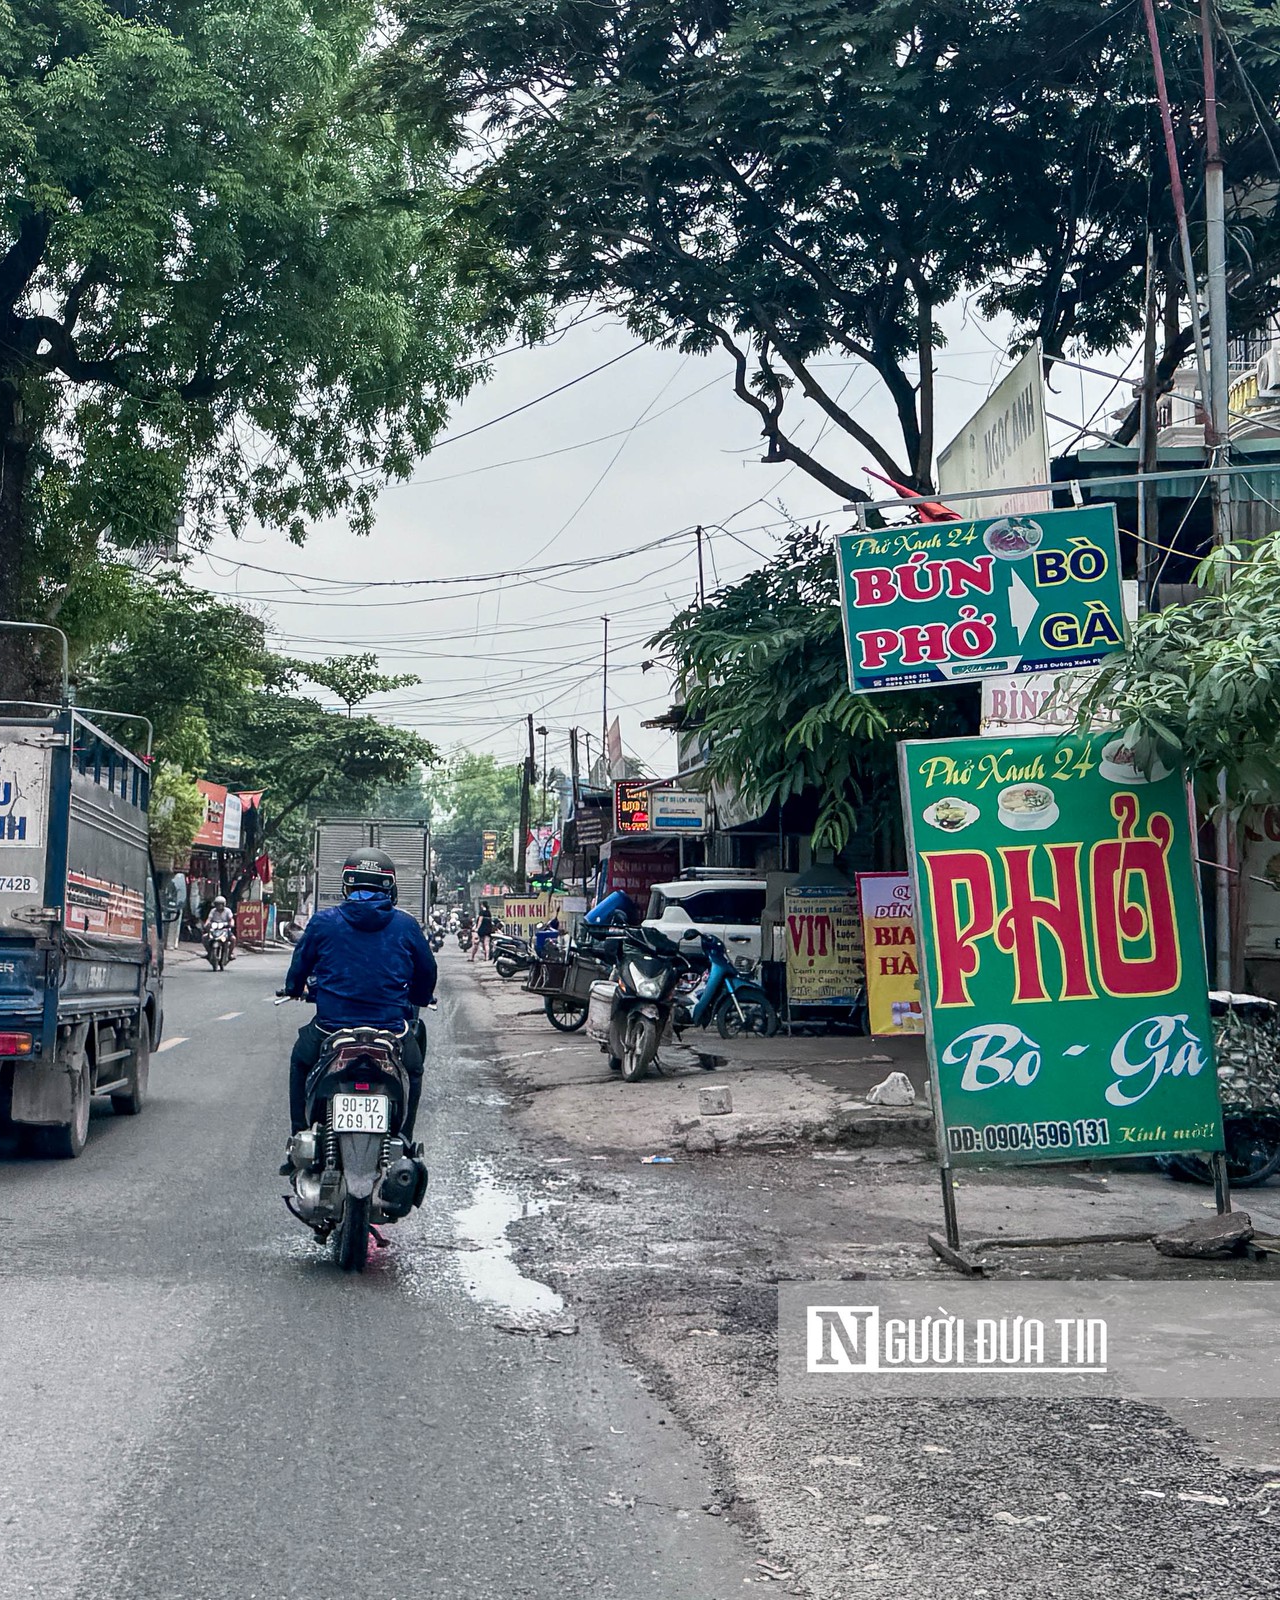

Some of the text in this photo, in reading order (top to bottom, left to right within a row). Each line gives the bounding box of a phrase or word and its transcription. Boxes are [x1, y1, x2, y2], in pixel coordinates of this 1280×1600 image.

[984, 409, 1012, 479] NGỌC
[1012, 381, 1036, 453] ANH
[946, 523, 979, 548] 24
[850, 552, 997, 608] BÚN
[1034, 536, 1108, 588] BÒ
[858, 605, 996, 670] PHỞ
[1038, 600, 1120, 651] GÀ
[919, 740, 1098, 790] Phở Xanh 24
[506, 904, 526, 918] KIM
[919, 792, 1183, 1009] PHỞ
[787, 914, 831, 967] VỊT
[873, 926, 917, 946] BIA
[878, 950, 919, 976] HÀ
[942, 1013, 1210, 1107] Bò Gà
[337, 1114, 384, 1129] 269.12
[342, 1098, 380, 1113] 90-B2
[984, 1124, 1032, 1151] 0904
[1034, 1121, 1073, 1148] 596
[1074, 1118, 1110, 1145] 131
[1115, 1127, 1167, 1143] Kính
